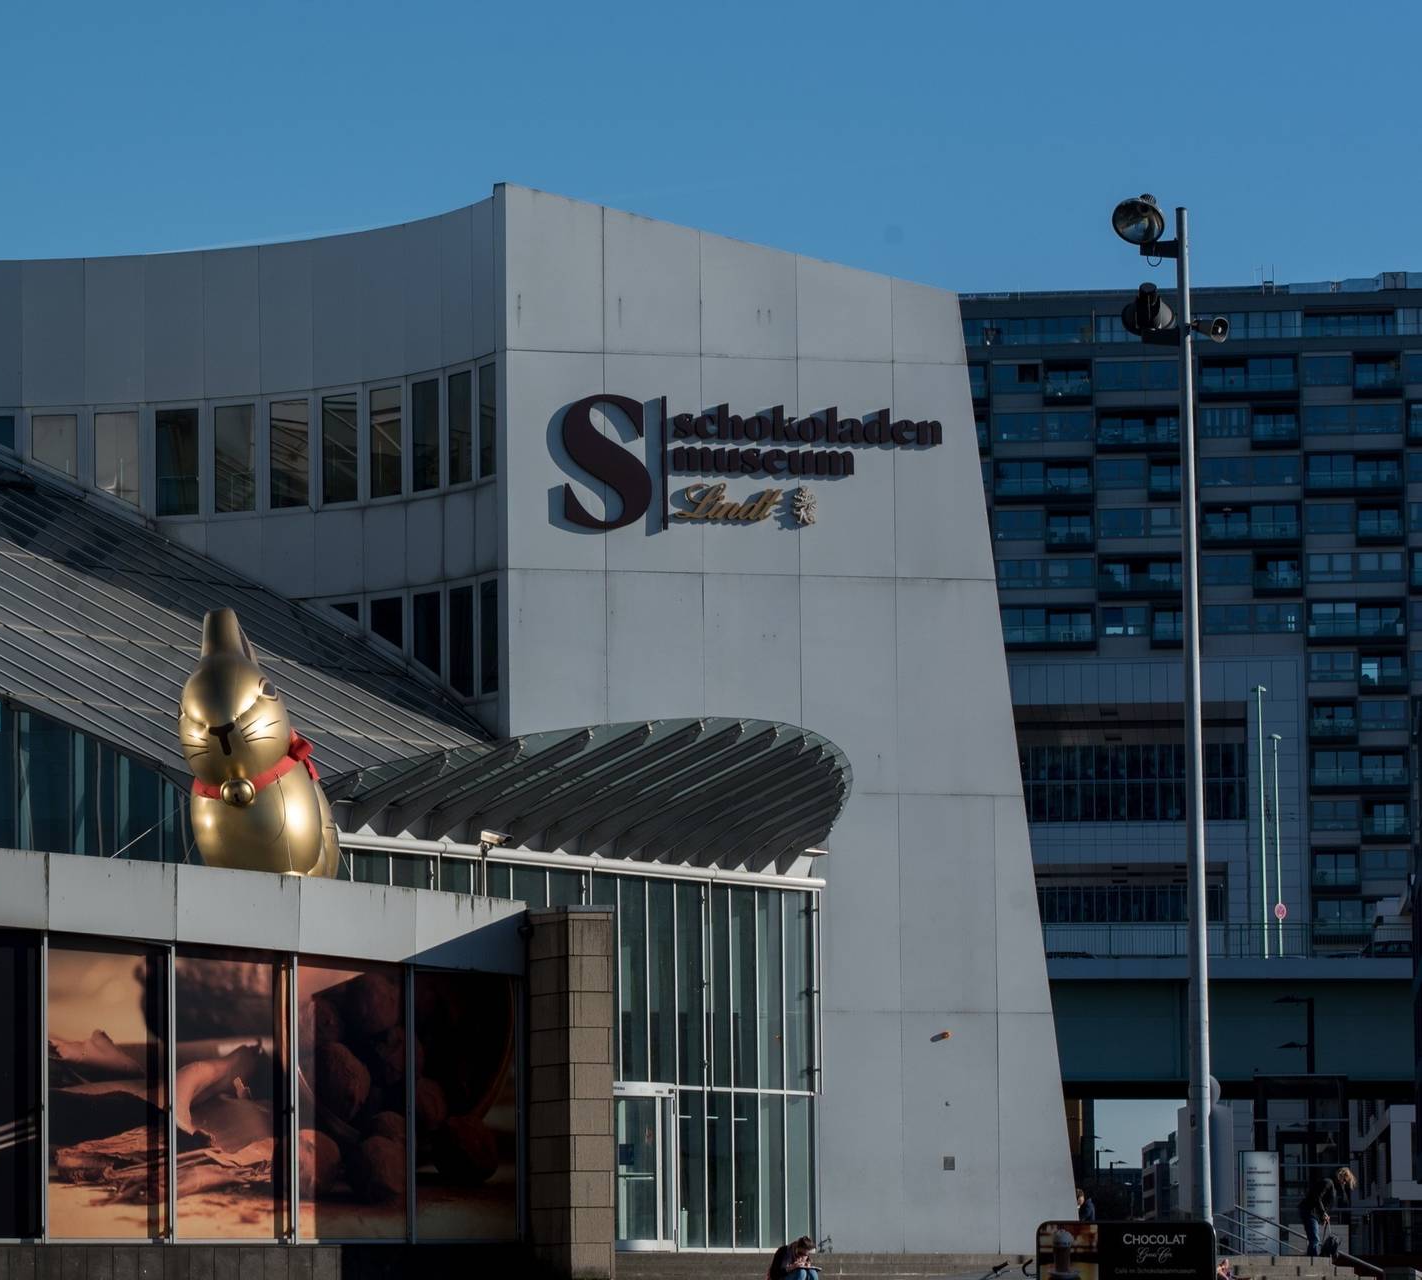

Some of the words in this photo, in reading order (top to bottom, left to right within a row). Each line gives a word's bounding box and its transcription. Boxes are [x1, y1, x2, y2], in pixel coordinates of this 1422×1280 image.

[673, 403, 943, 445] schokoladen
[563, 394, 652, 530] S
[673, 444, 855, 476] museum
[676, 483, 783, 521] Lindt
[1122, 1233, 1187, 1245] CHOCOLAT
